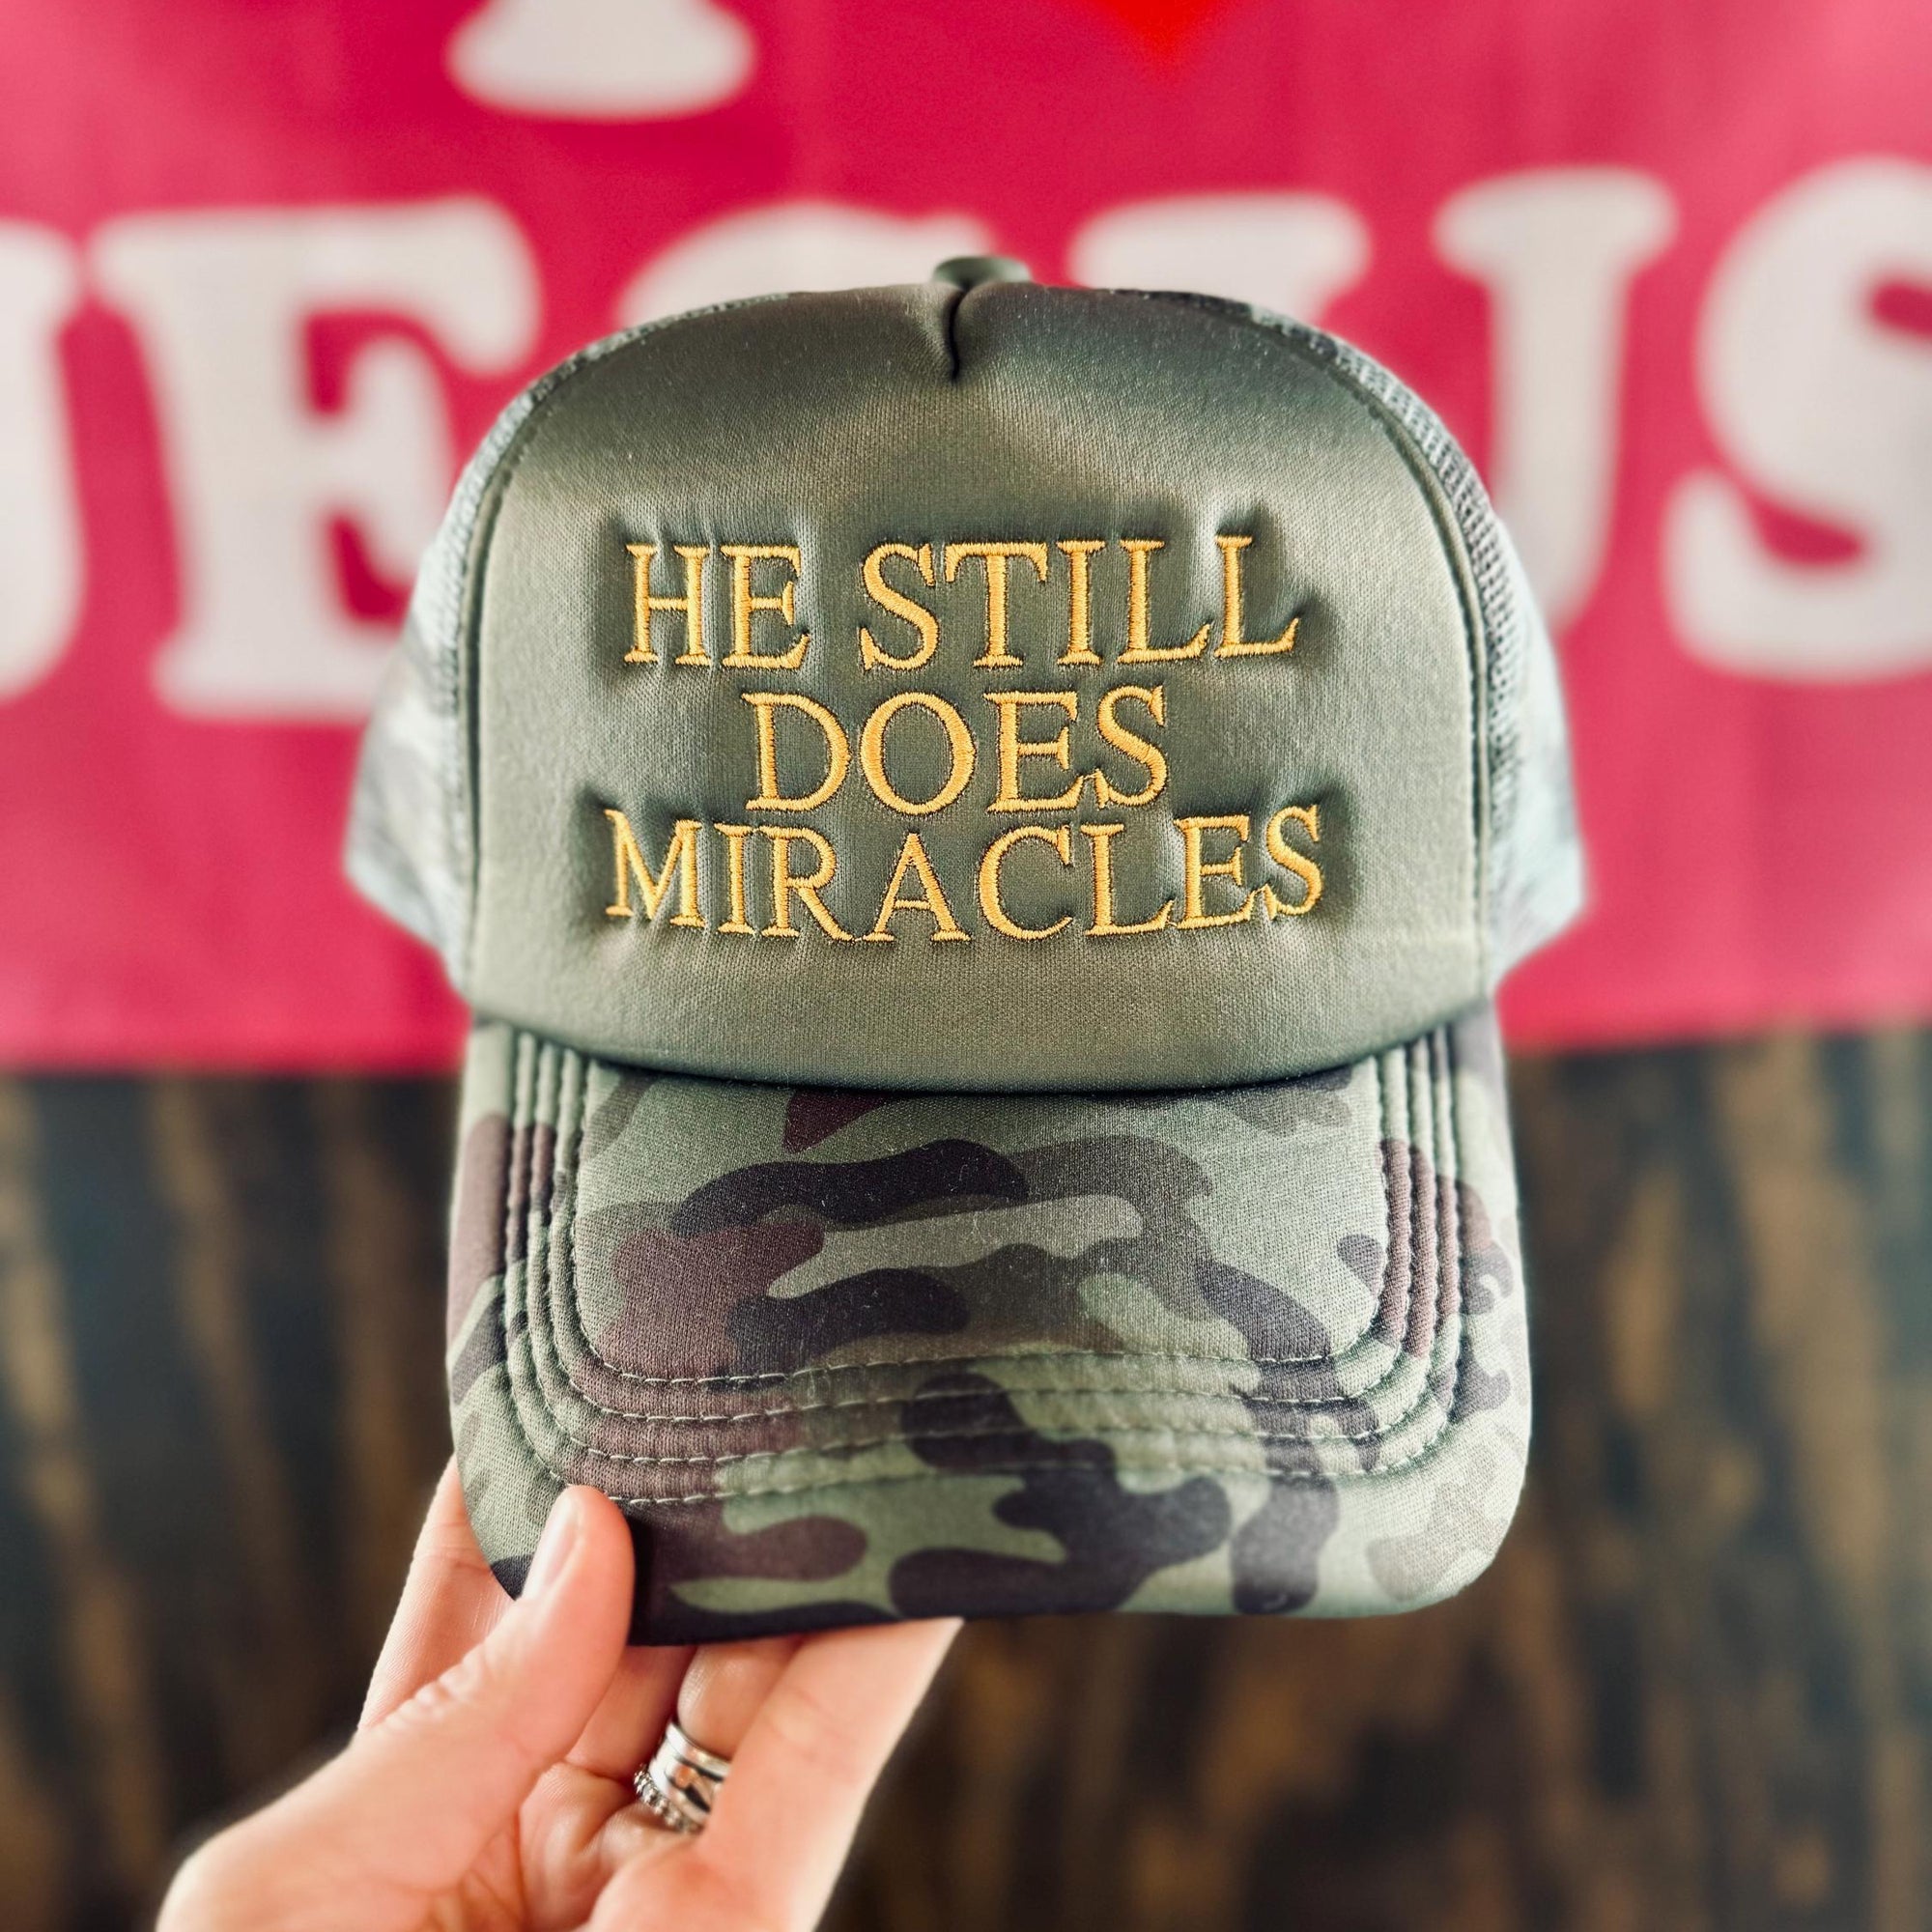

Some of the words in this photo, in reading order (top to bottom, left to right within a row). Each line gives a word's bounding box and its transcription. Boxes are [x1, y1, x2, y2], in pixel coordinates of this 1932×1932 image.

[624, 542, 810, 670] HE
[859, 534, 1300, 671] STILL
[742, 684, 1169, 816] DOES
[604, 804, 1324, 942] MIRACLES
